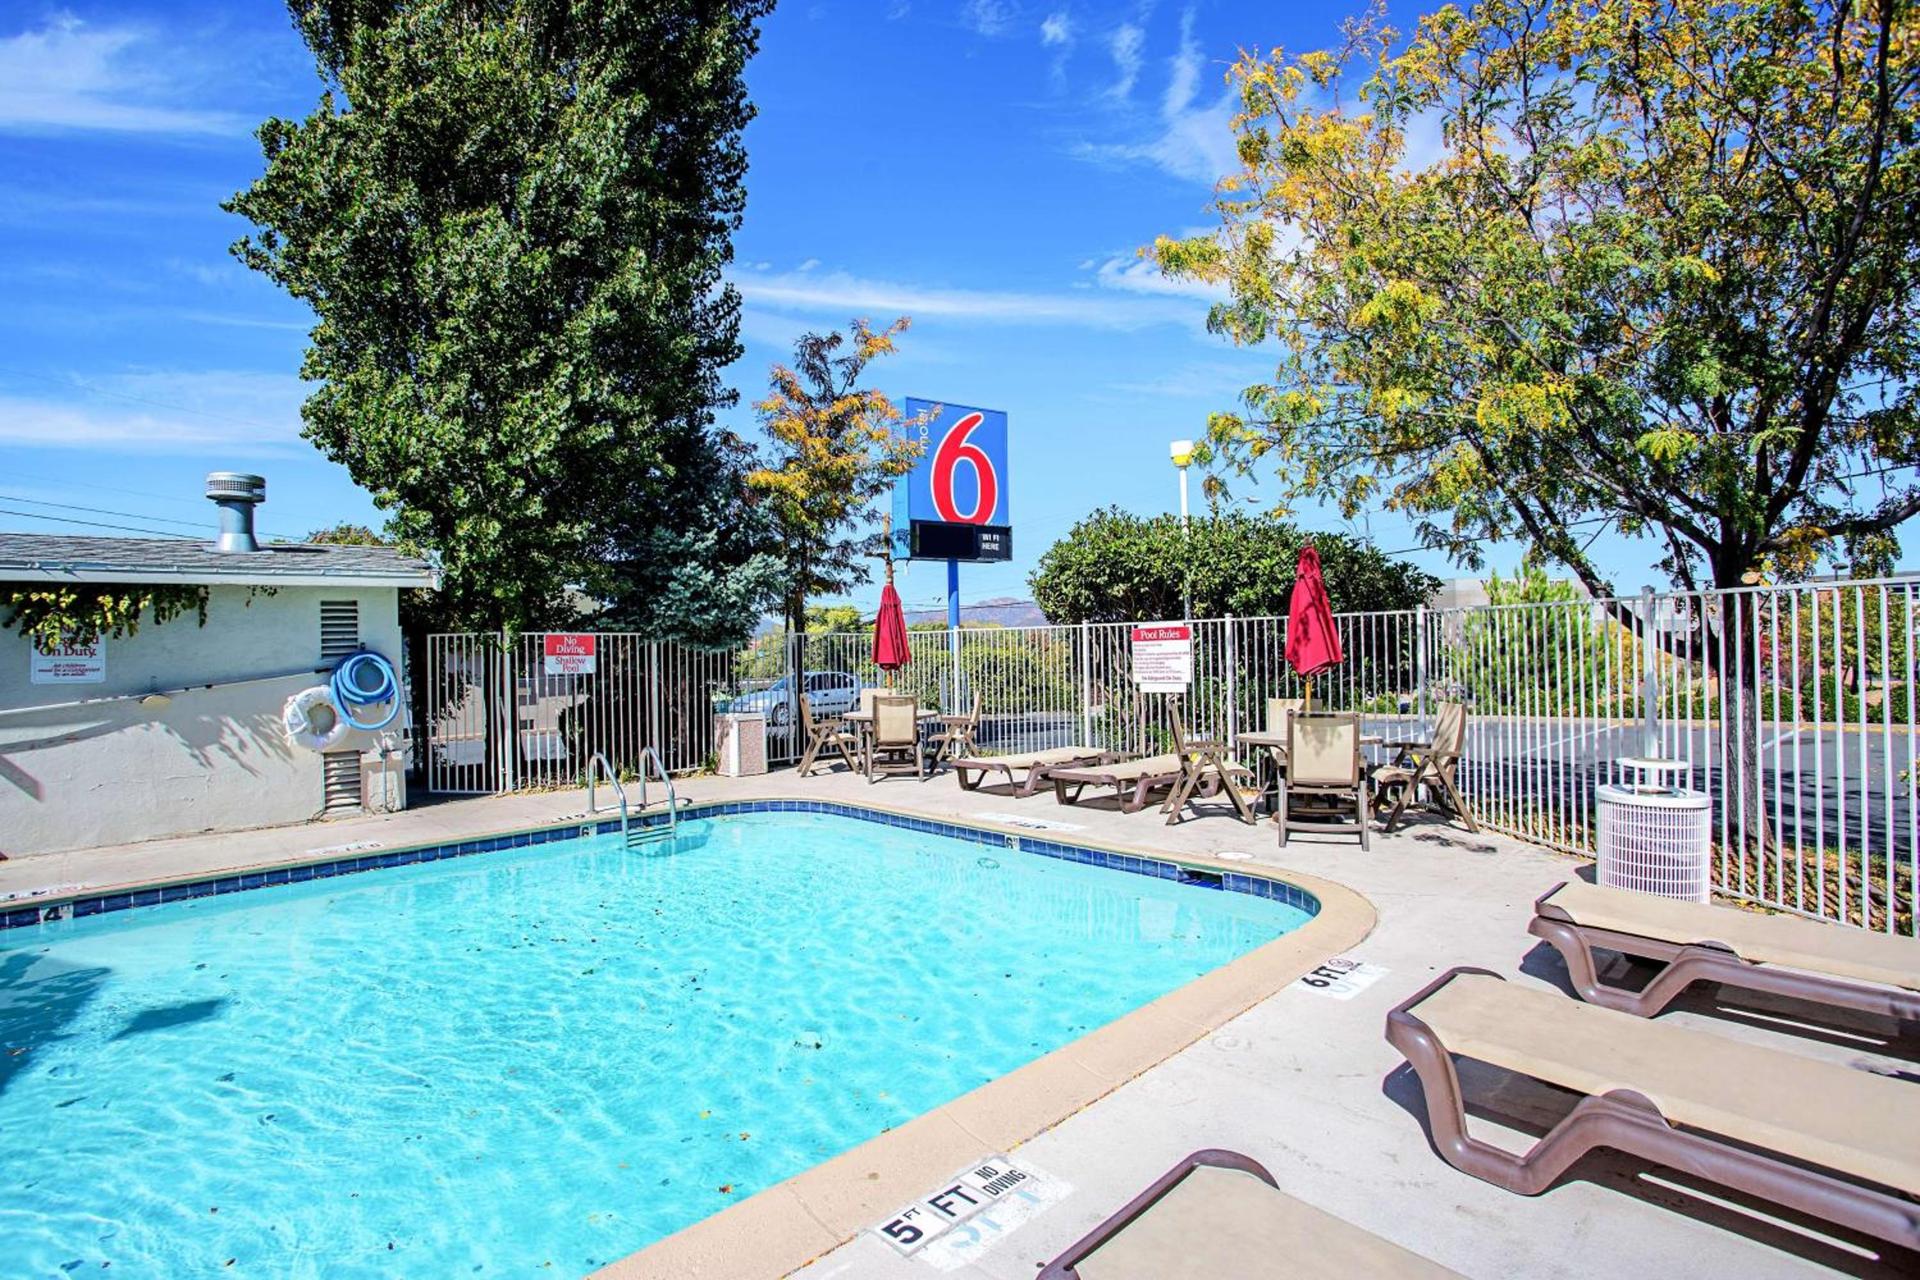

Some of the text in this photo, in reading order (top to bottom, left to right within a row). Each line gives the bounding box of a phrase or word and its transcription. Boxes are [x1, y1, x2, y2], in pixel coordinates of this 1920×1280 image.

[930, 411, 999, 526] 6
[981, 542, 1000, 551] HERE
[564, 636, 577, 645] No
[1140, 629, 1180, 639] Pool Rules
[556, 644, 586, 655] Diving
[555, 656, 586, 665] Shallow
[562, 663, 580, 673] Pool
[43, 906, 63, 921] 4
[974, 1165, 1000, 1181] NO
[982, 1169, 1028, 1197] DIVING
[928, 1184, 979, 1218] FT
[881, 1207, 925, 1245] 5 FT
